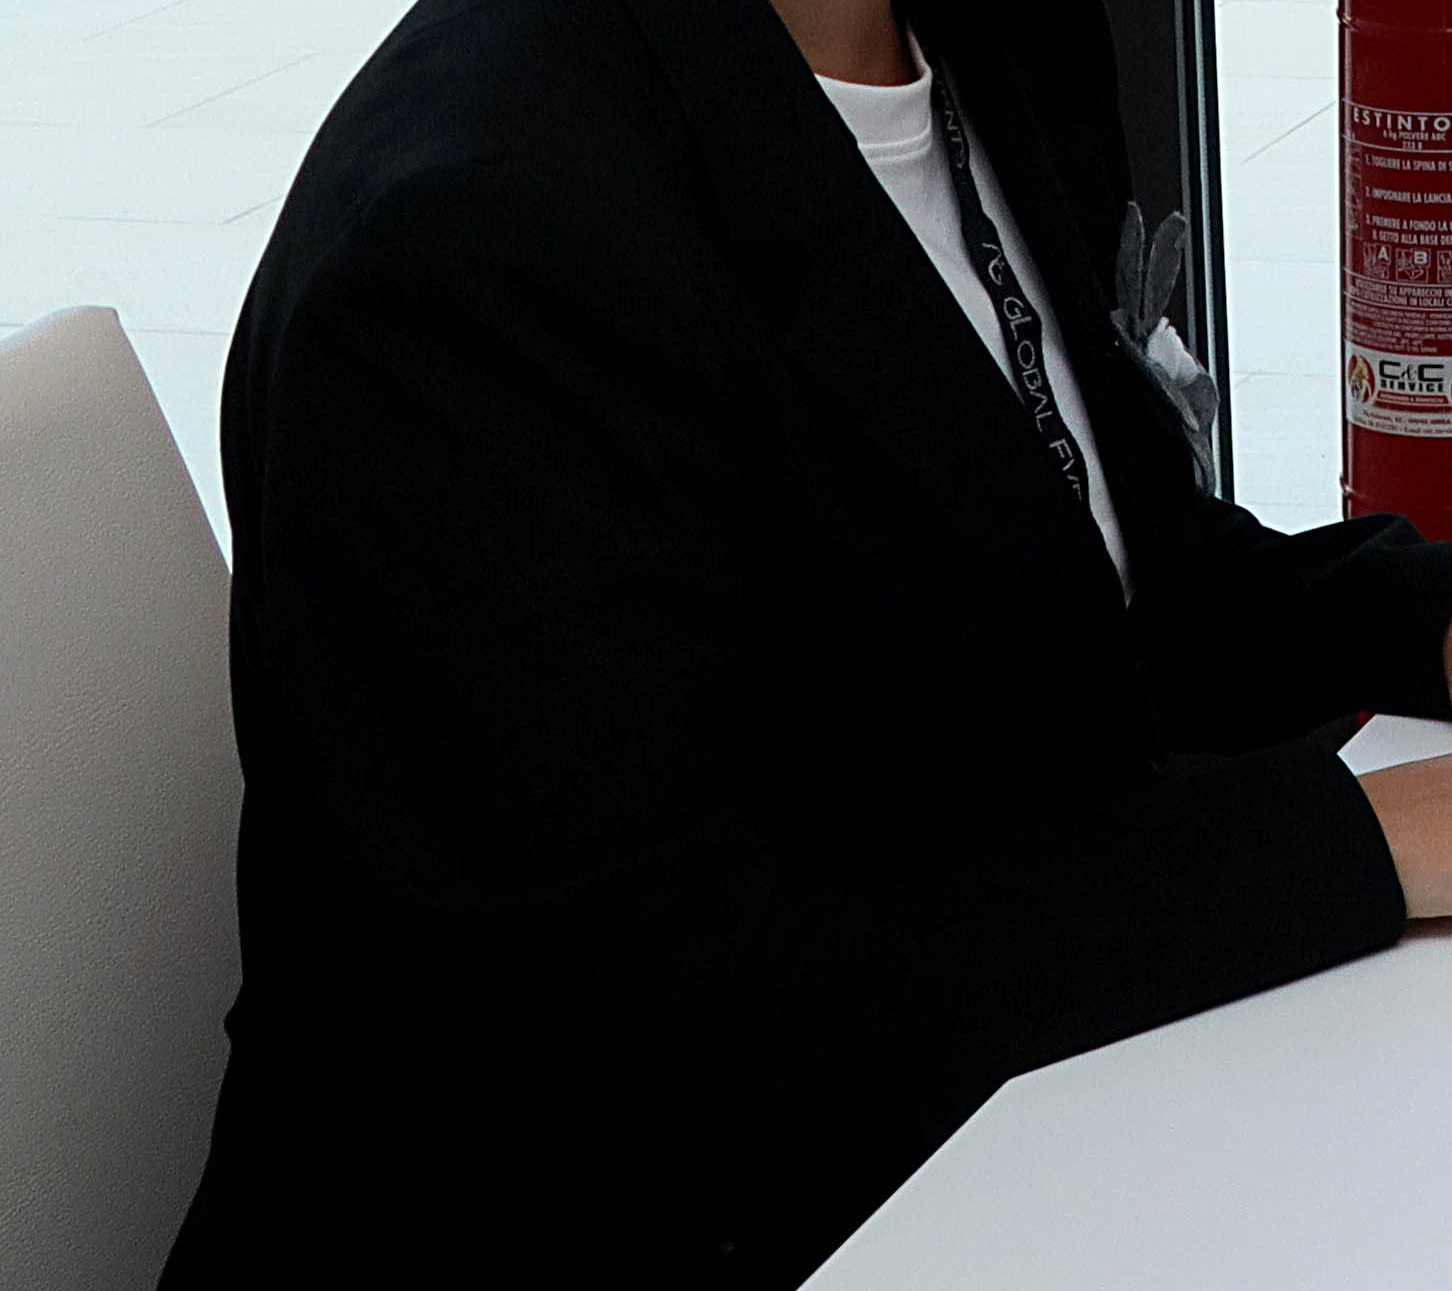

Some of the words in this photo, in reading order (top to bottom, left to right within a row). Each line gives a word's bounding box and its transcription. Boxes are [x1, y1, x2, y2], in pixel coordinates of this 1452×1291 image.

[1402, 159, 1411, 171] LA
[1413, 159, 1436, 171] SPINA
[1438, 160, 1447, 171] DI
[1412, 192, 1422, 203] LA
[1424, 192, 1452, 204] LANCIA
[1402, 219, 1408, 230] A
[1409, 219, 1436, 231] FONDO
[1437, 220, 1448, 231] LA
[1379, 230, 1399, 243] GETTO
[1401, 233, 1418, 244] ALLA
[1419, 234, 1438, 245] BASE
[1377, 246, 1390, 261] A
[1413, 250, 1428, 265] B
[1444, 287, 1452, 297] IN
[1419, 297, 1444, 307] LOCALI
[1003, 294, 1054, 433] GLOBAL
[1379, 360, 1444, 382] C&C
[1380, 379, 1444, 392] SERVICE
